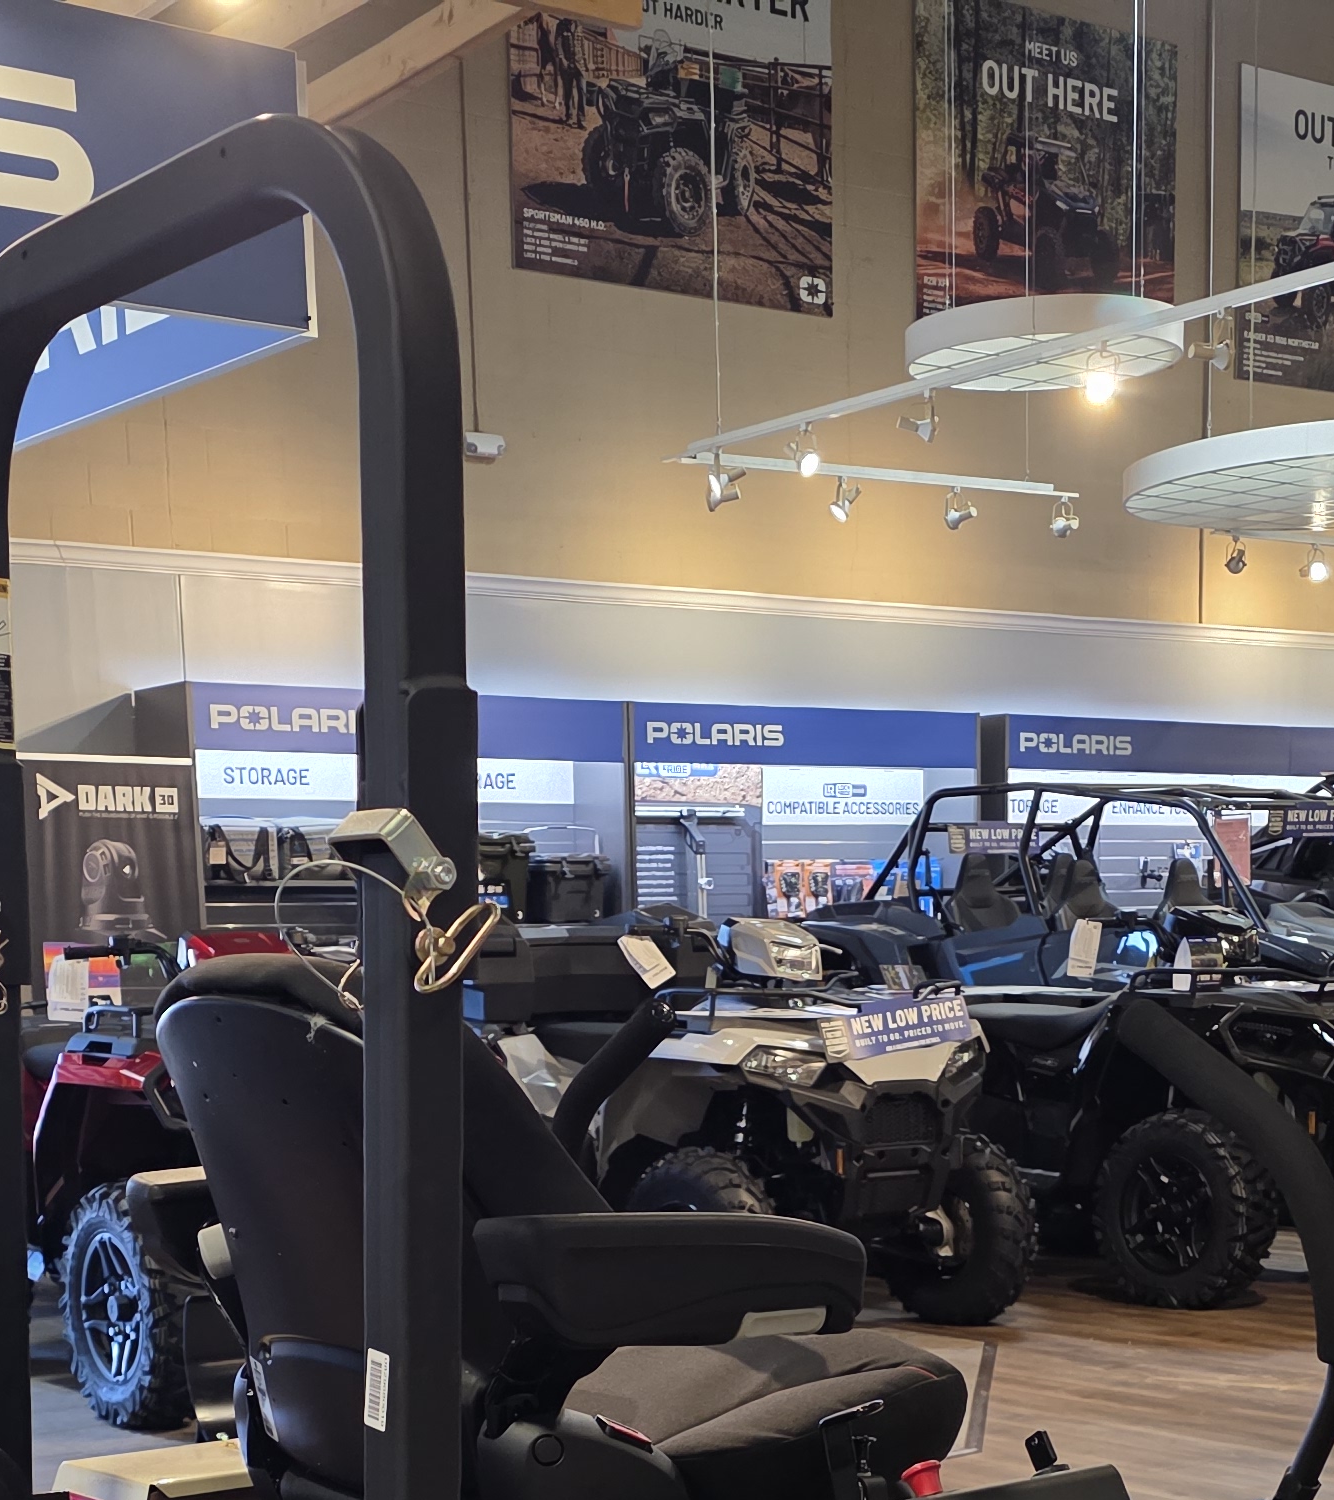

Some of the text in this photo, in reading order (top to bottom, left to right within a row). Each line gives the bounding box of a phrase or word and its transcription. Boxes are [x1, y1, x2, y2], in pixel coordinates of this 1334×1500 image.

[1025, 40, 1078, 67] MEET US
[982, 59, 1118, 123] OUT HERE
[523, 207, 573, 225] SPORTSMAN
[573, 217, 589, 229] 450
[209, 704, 356, 734] POLARI
[646, 721, 785, 747] POLARIS
[1019, 732, 1133, 755] POLARIS
[223, 767, 310, 786] STORAGE
[77, 784, 175, 812] DARK 30
[767, 801, 919, 815] COMPATIBLE ACCESSORIES
[1288, 810, 1307, 822] NEW
[1309, 810, 1328, 821] LOW
[969, 829, 989, 839] NEW
[991, 829, 1010, 839] LOW
[1012, 828, 1038, 839] PRE
[850, 999, 964, 1035] NEW LOW PRICE
[878, 1034, 888, 1042] TO
[904, 1026, 932, 1038] PRICED
[933, 1024, 943, 1033] TO
[945, 1020, 967, 1031] MOVE.
